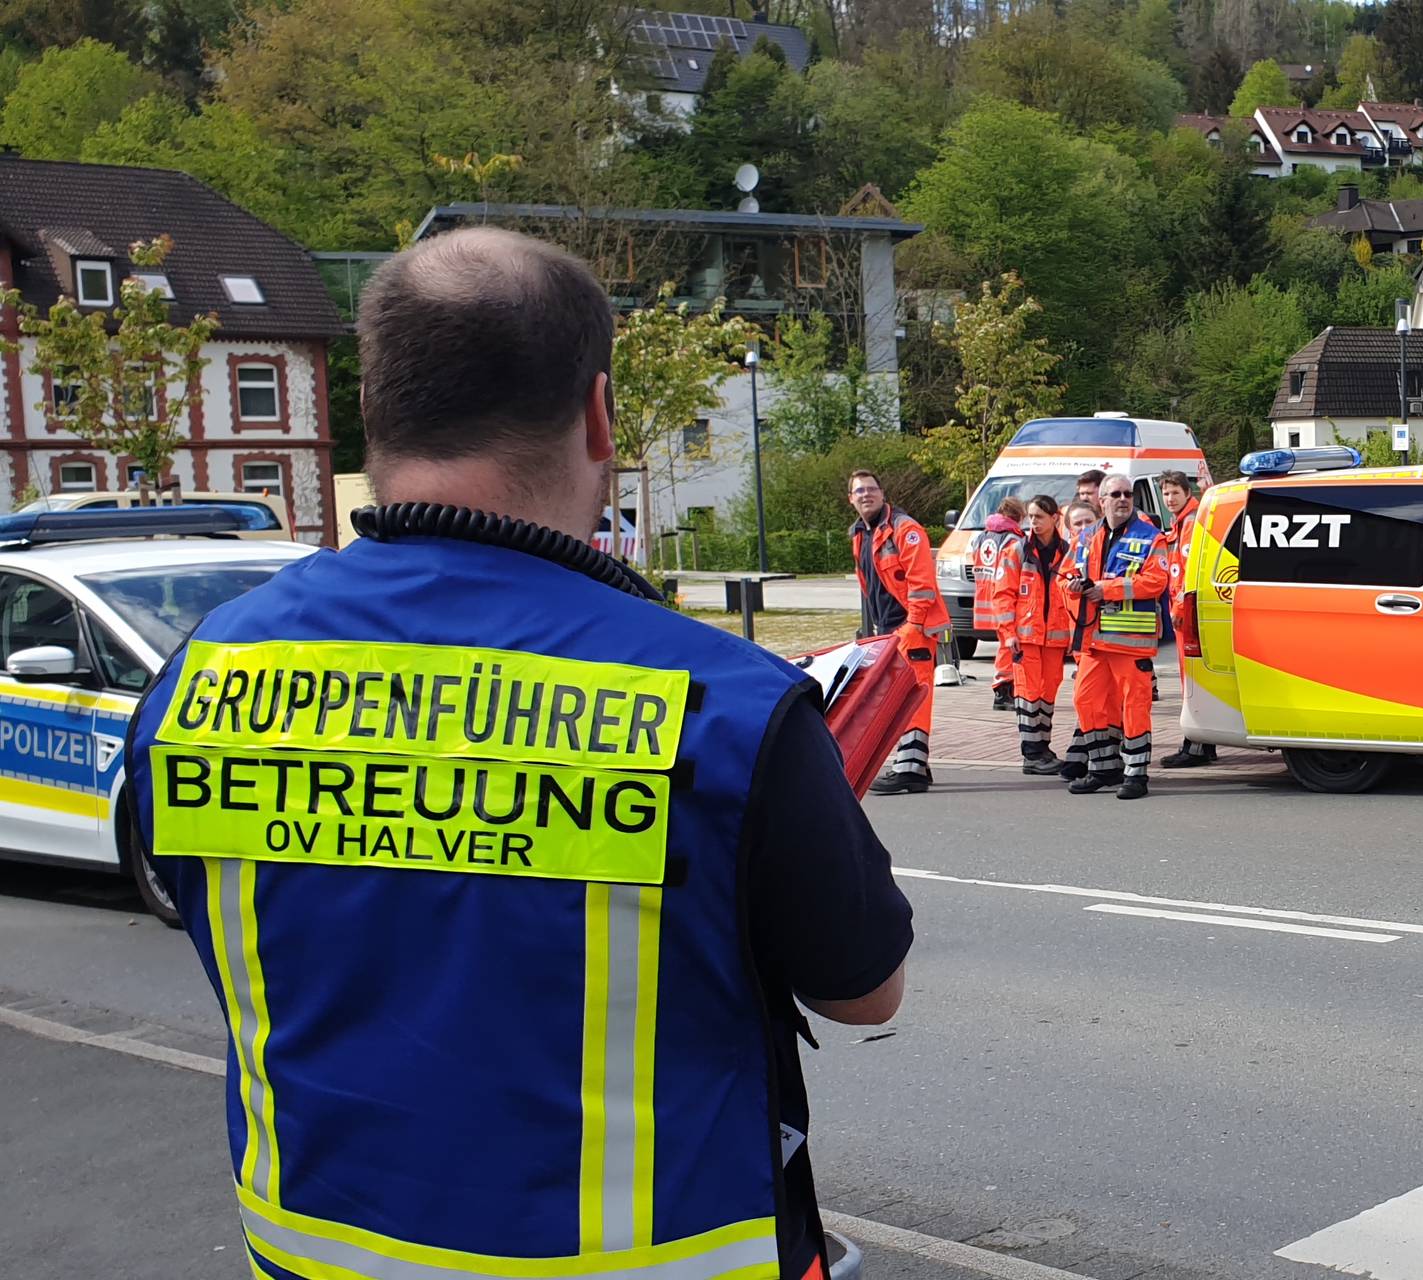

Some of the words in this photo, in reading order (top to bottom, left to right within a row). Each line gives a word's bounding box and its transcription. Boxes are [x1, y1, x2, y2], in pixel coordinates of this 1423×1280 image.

[1242, 514, 1351, 548] ARZT
[176, 662, 668, 756] GRUPPENFÜHRER
[0, 720, 92, 767] POLIZEI
[165, 754, 658, 834] BETREUUNG
[265, 819, 321, 854] OV
[337, 823, 534, 867] HALVER
